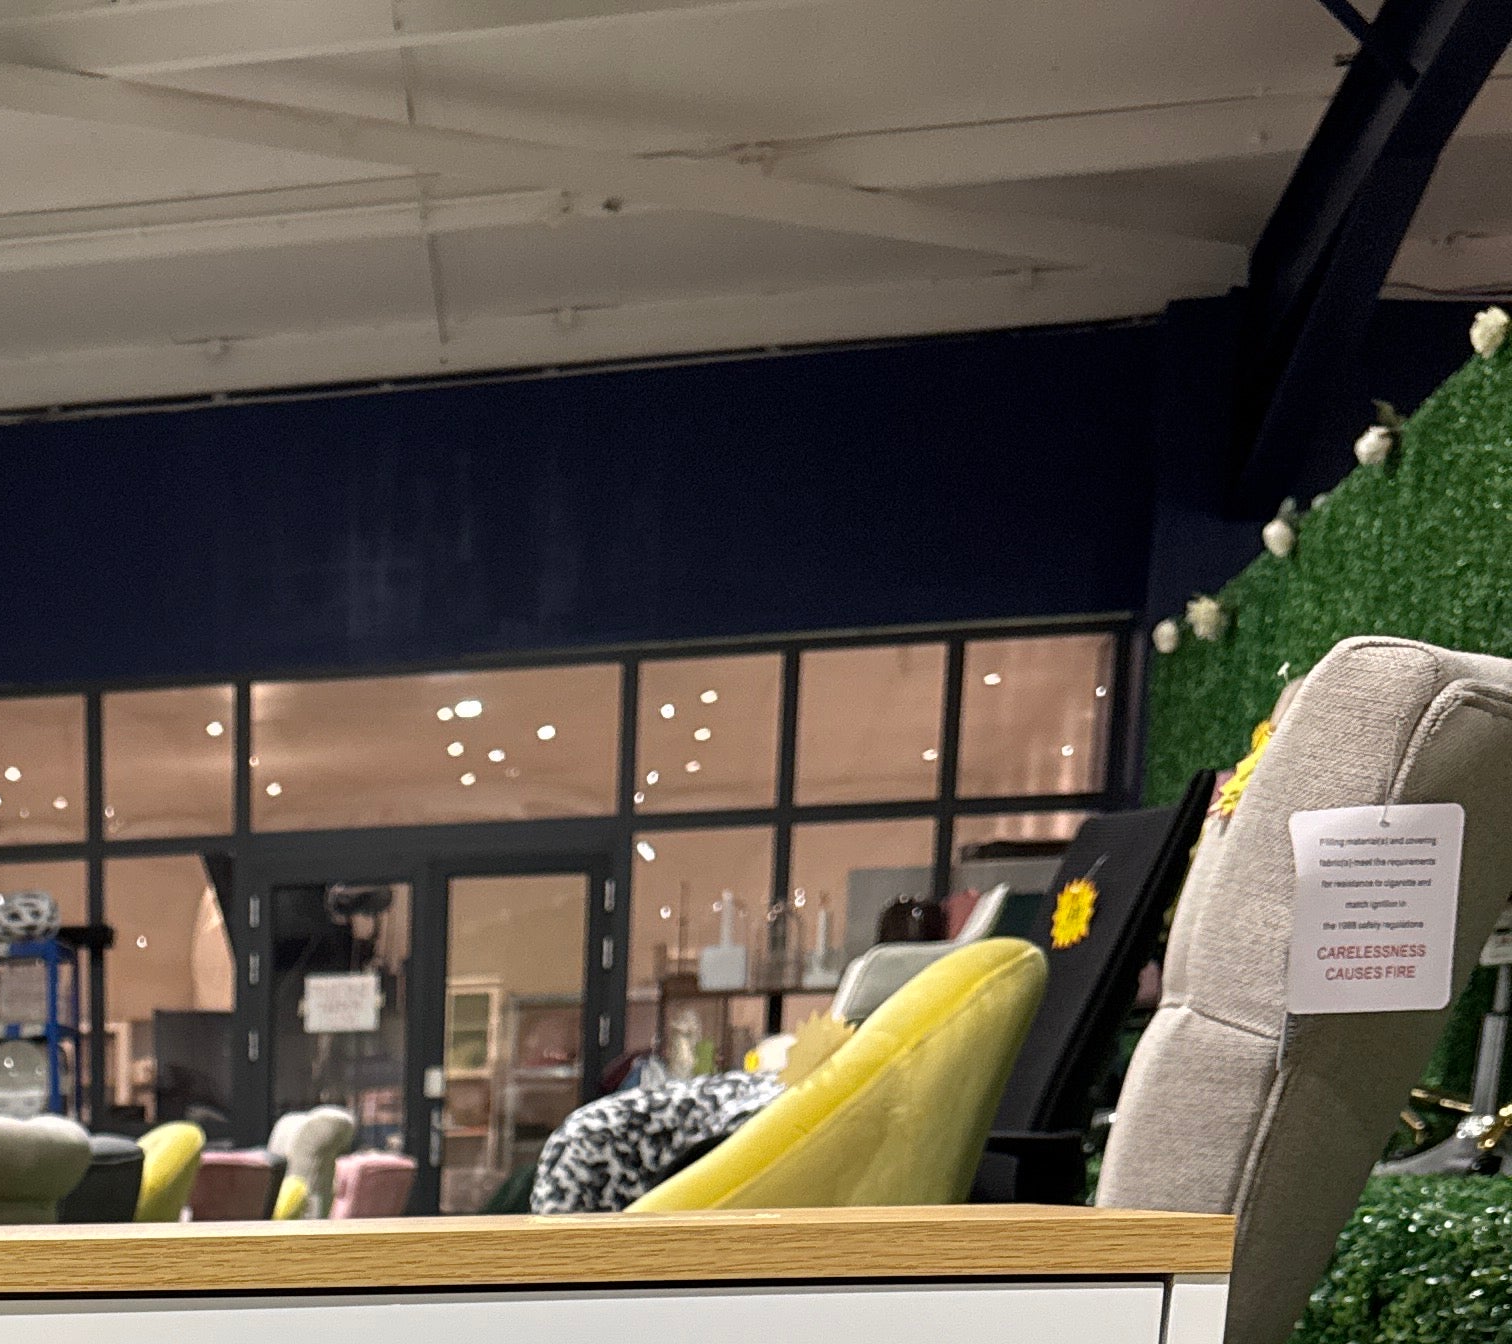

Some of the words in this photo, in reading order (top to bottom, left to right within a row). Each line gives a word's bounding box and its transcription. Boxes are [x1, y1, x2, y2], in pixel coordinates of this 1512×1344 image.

[1390, 837, 1404, 845] and
[1406, 837, 1436, 847] covering
[1373, 857, 1386, 866] the
[1387, 858, 1435, 867] requirements
[1321, 880, 1333, 888] for
[1383, 879, 1416, 889] cigarette
[1417, 878, 1431, 886] and
[1370, 900, 1398, 910] ignition
[1323, 922, 1336, 930] the
[1358, 920, 1381, 930] safety
[1383, 920, 1424, 930] regulations
[1317, 944, 1427, 961] CARELESSNESS
[1325, 966, 1383, 980] CAUSES
[1385, 965, 1416, 979] FIRE
